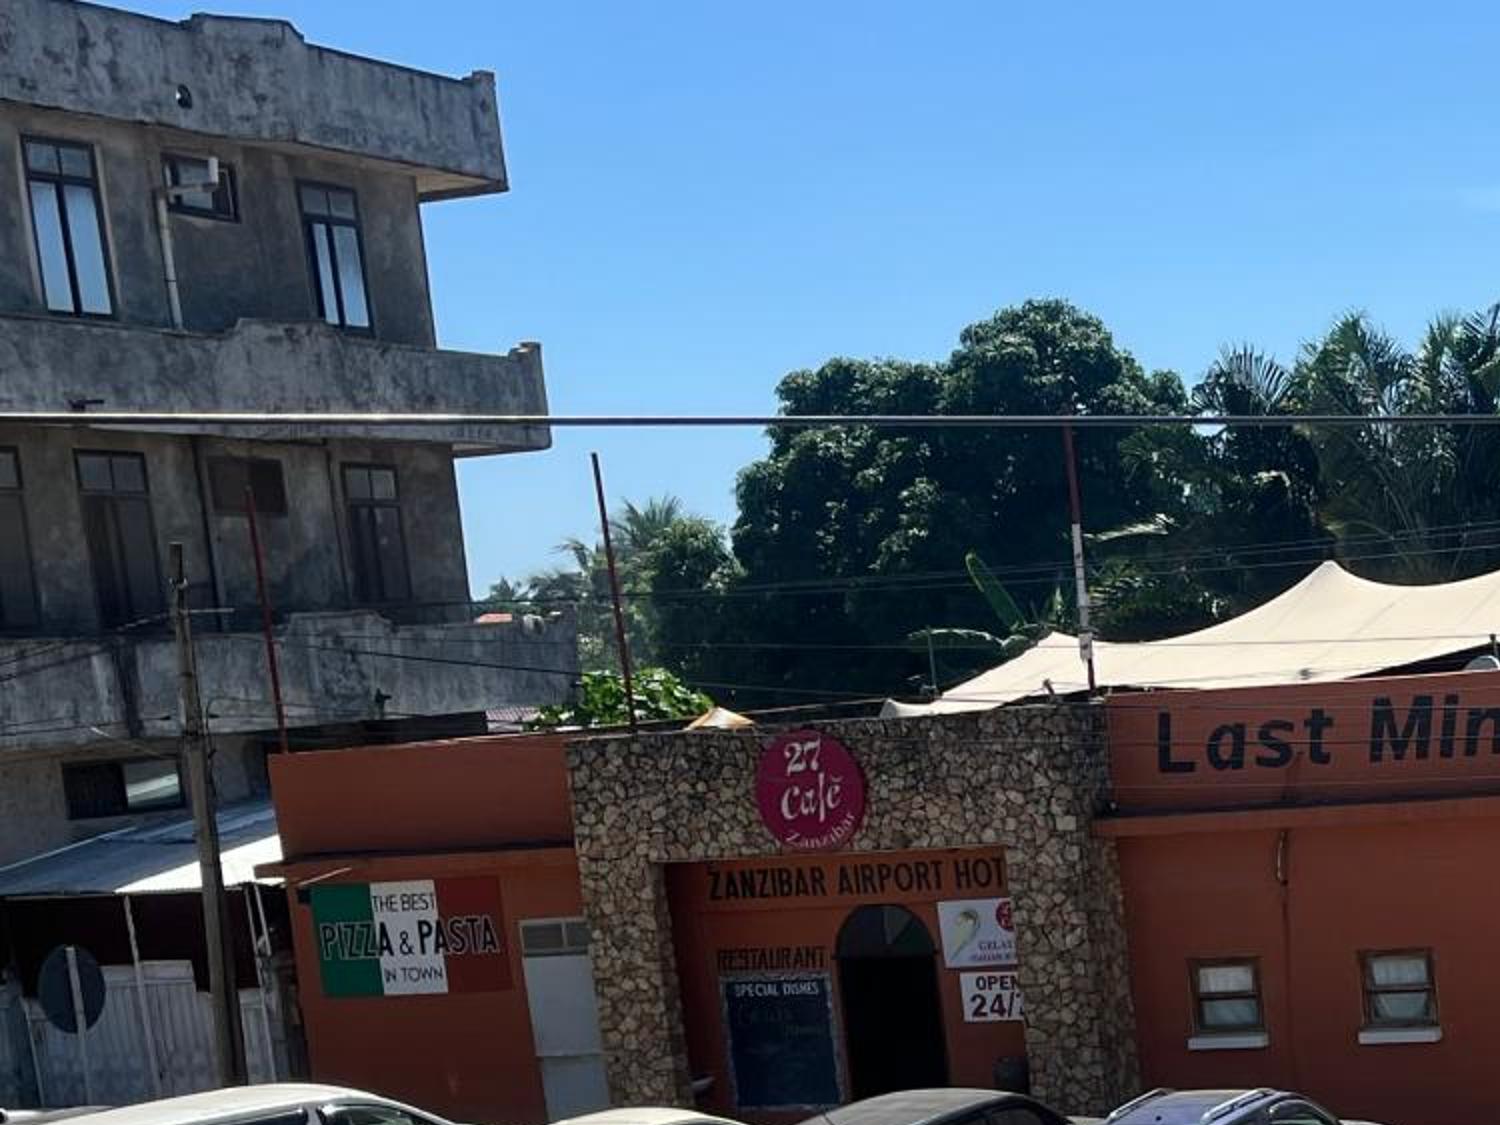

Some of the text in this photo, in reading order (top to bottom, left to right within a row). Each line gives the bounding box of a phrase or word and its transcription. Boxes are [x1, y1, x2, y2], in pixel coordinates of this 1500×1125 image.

[784, 736, 821, 777] 27
[1157, 707, 1334, 774] Last
[707, 863, 828, 901] ZANZIBAR
[837, 859, 944, 897] AIRPORT
[372, 892, 435, 913] THE BEST
[319, 914, 500, 961] PIZZA & PASTA
[717, 945, 827, 971] RESTAURANT
[384, 966, 444, 984] IN TOWN
